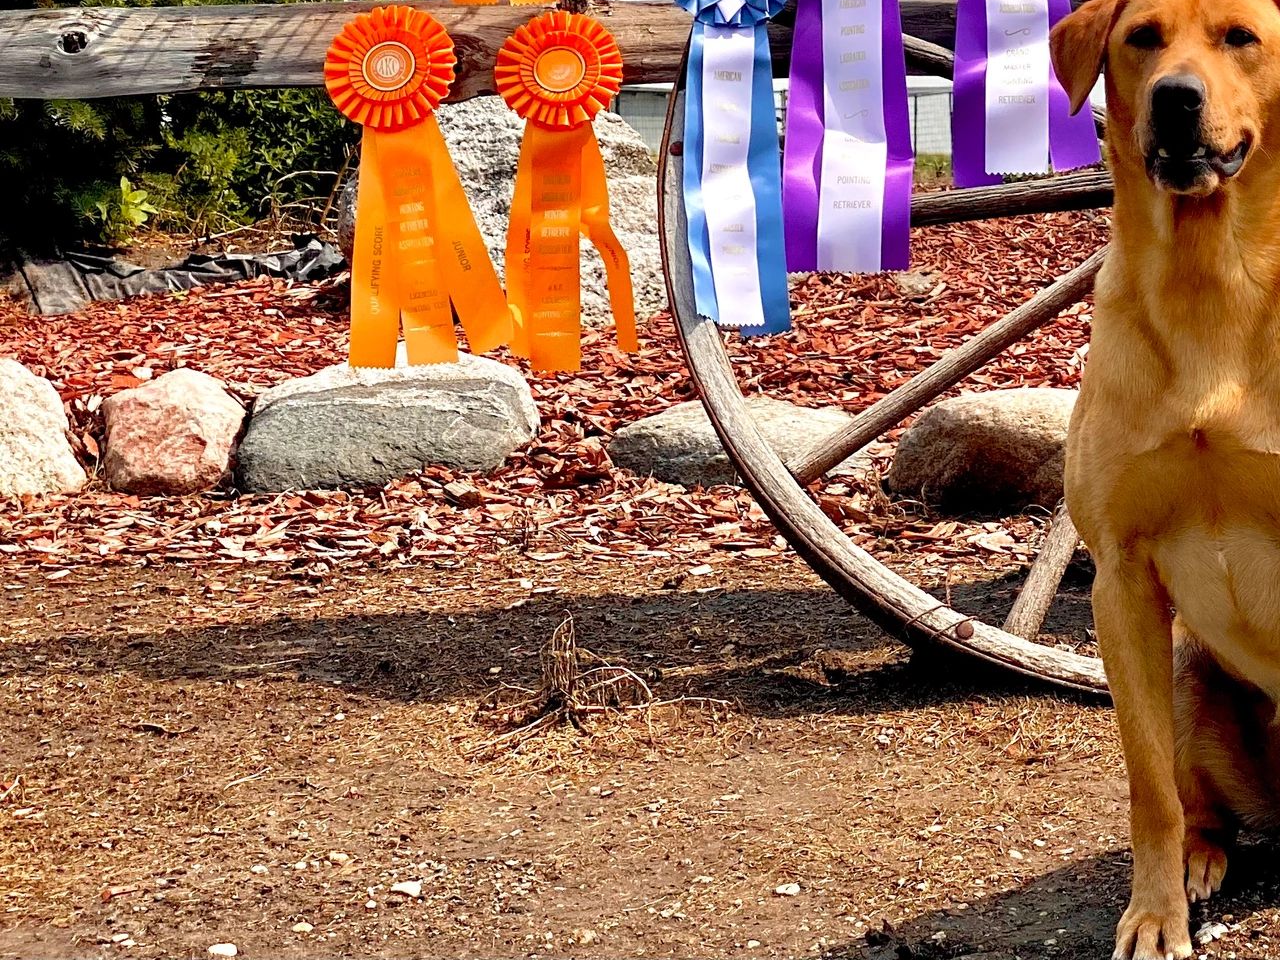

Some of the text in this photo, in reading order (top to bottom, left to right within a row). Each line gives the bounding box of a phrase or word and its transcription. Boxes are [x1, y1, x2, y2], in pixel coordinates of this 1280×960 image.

[378, 57, 398, 76] AKC
[713, 70, 742, 82] AMERICAN
[998, 95, 1036, 104] RETRIEVER
[837, 175, 871, 185] POINTING
[833, 200, 872, 210] RETRIEVER
[373, 225, 384, 256] SCORE
[451, 240, 472, 273] JUNIOR
